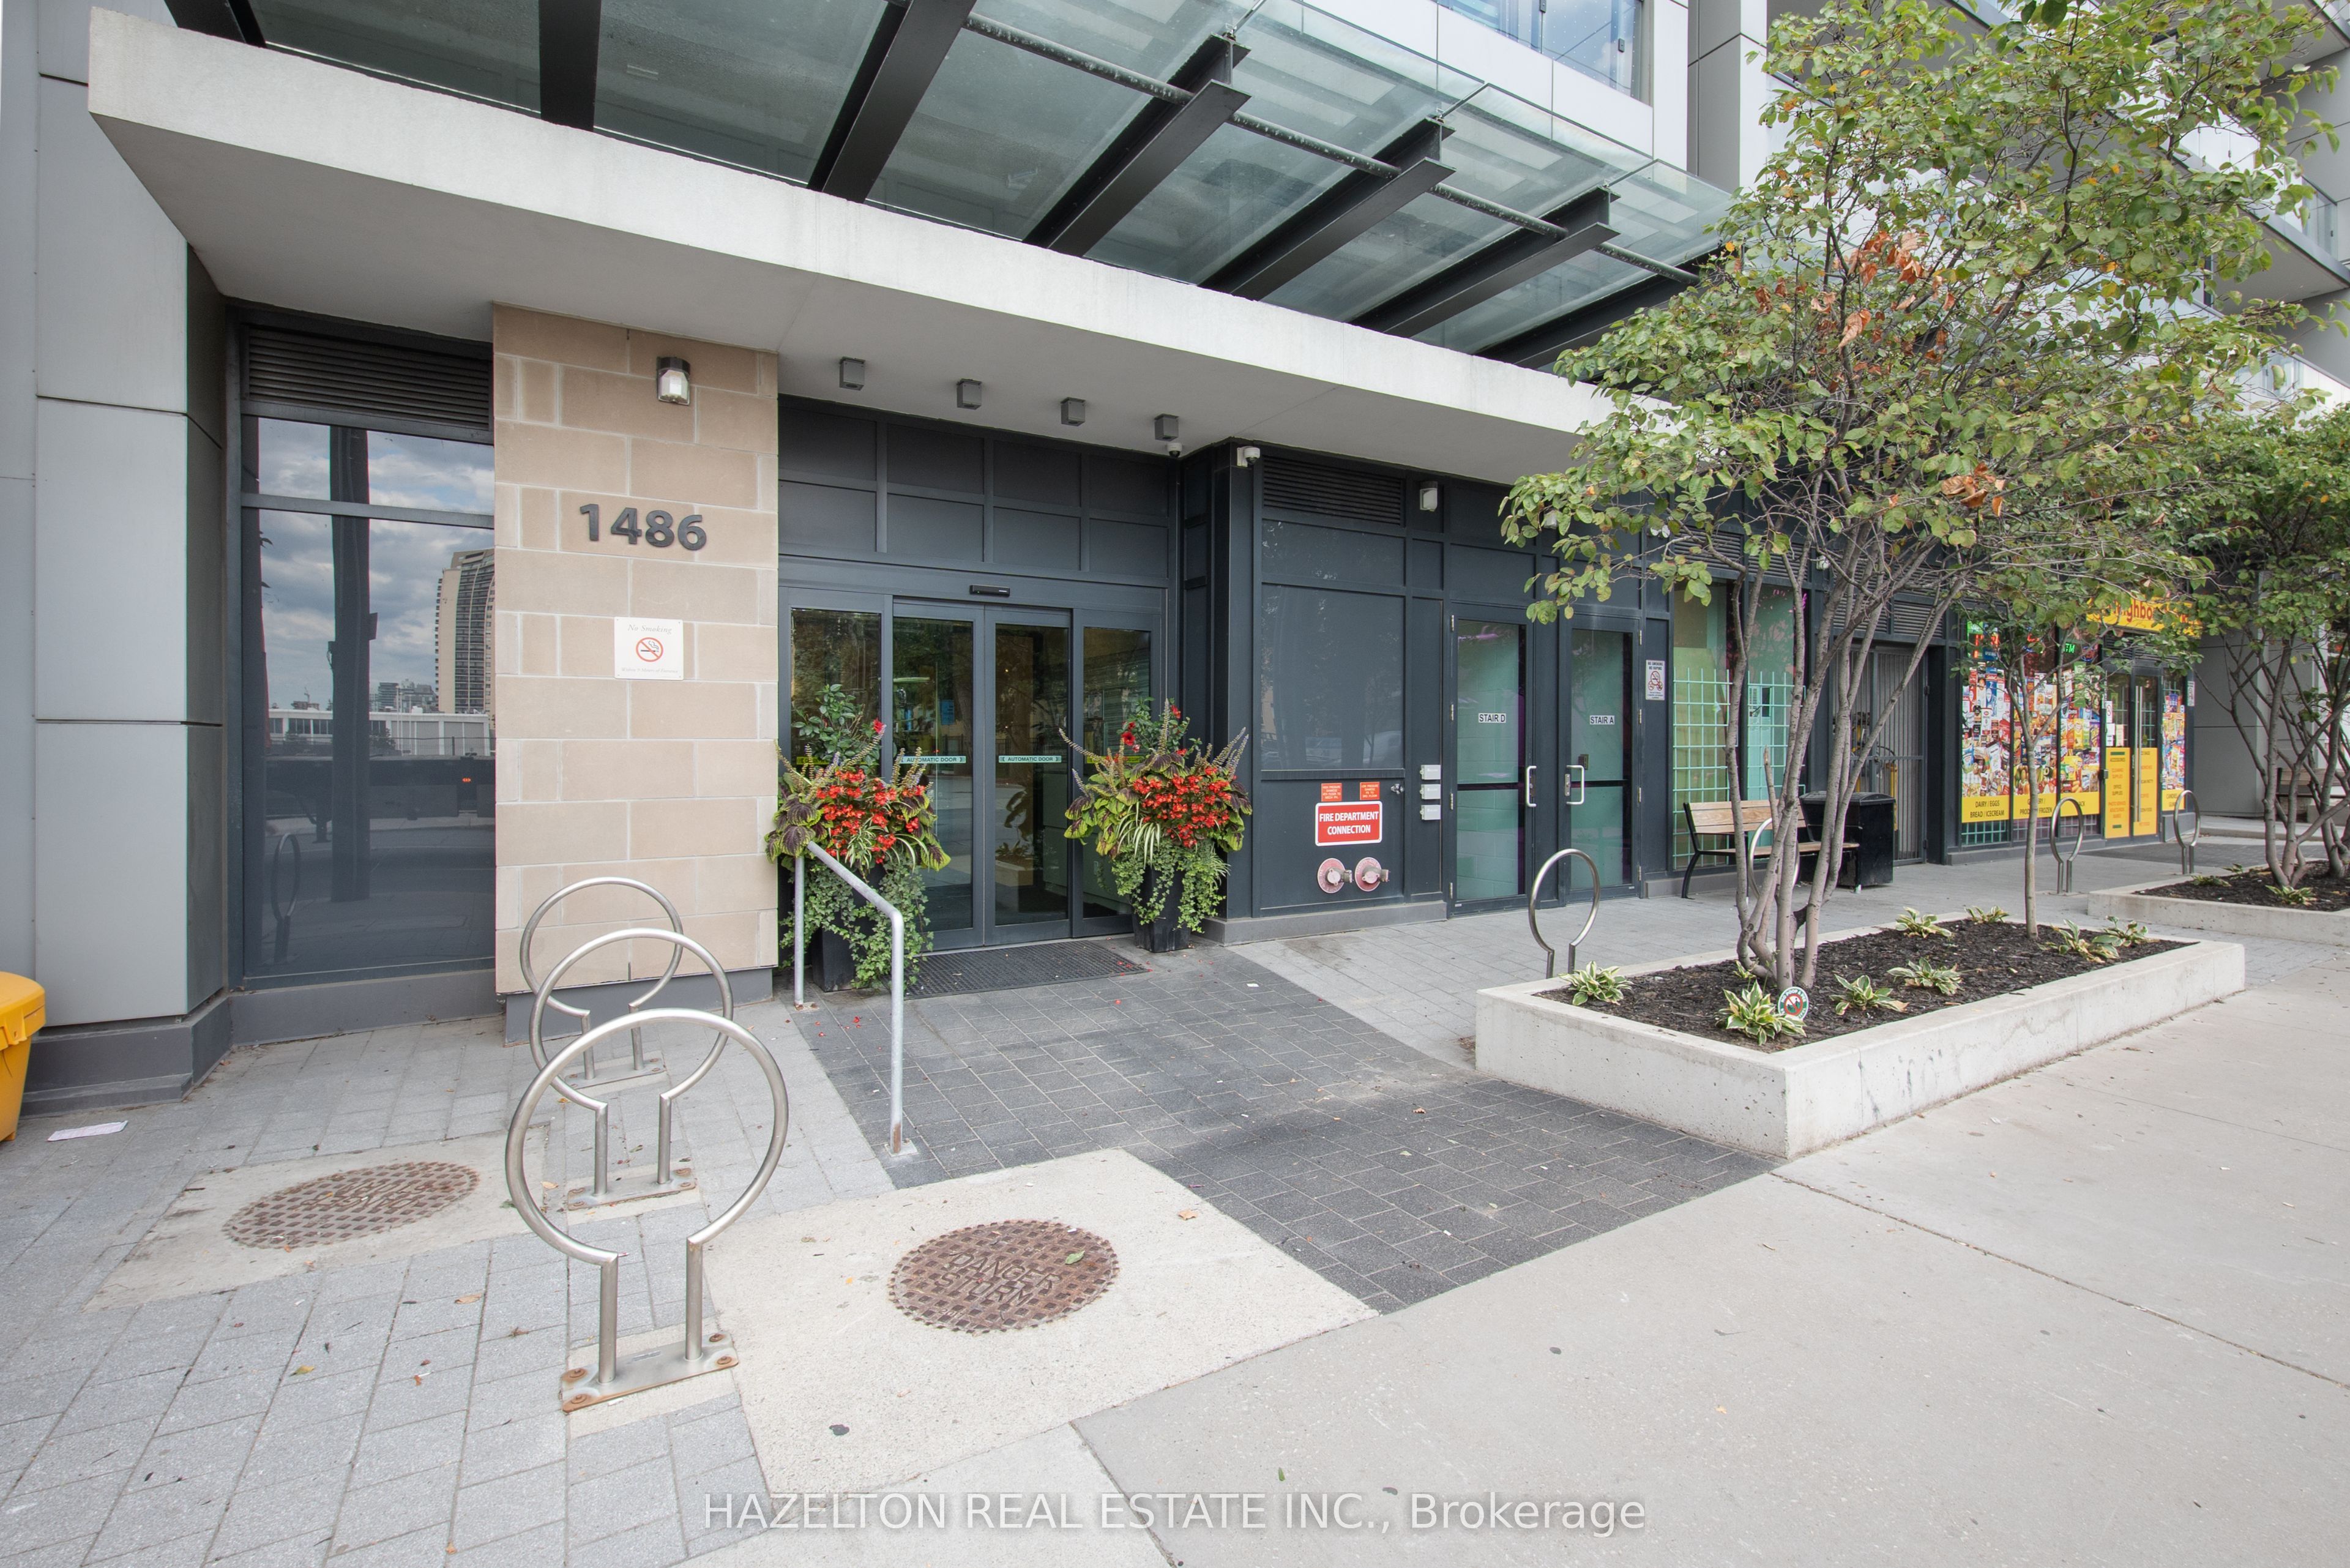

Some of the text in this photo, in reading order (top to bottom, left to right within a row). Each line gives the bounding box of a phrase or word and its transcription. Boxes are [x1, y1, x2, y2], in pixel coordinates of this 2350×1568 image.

[580, 503, 707, 551] 1486
[641, 625, 672, 635] Smoking
[1479, 714, 1499, 722] STAIR
[1319, 811, 1379, 822] FIRE DEPARTMENT
[1327, 824, 1371, 835] CONNECTION
[949, 1252, 1062, 1293] DANGER
[934, 1271, 1034, 1307] STORM
